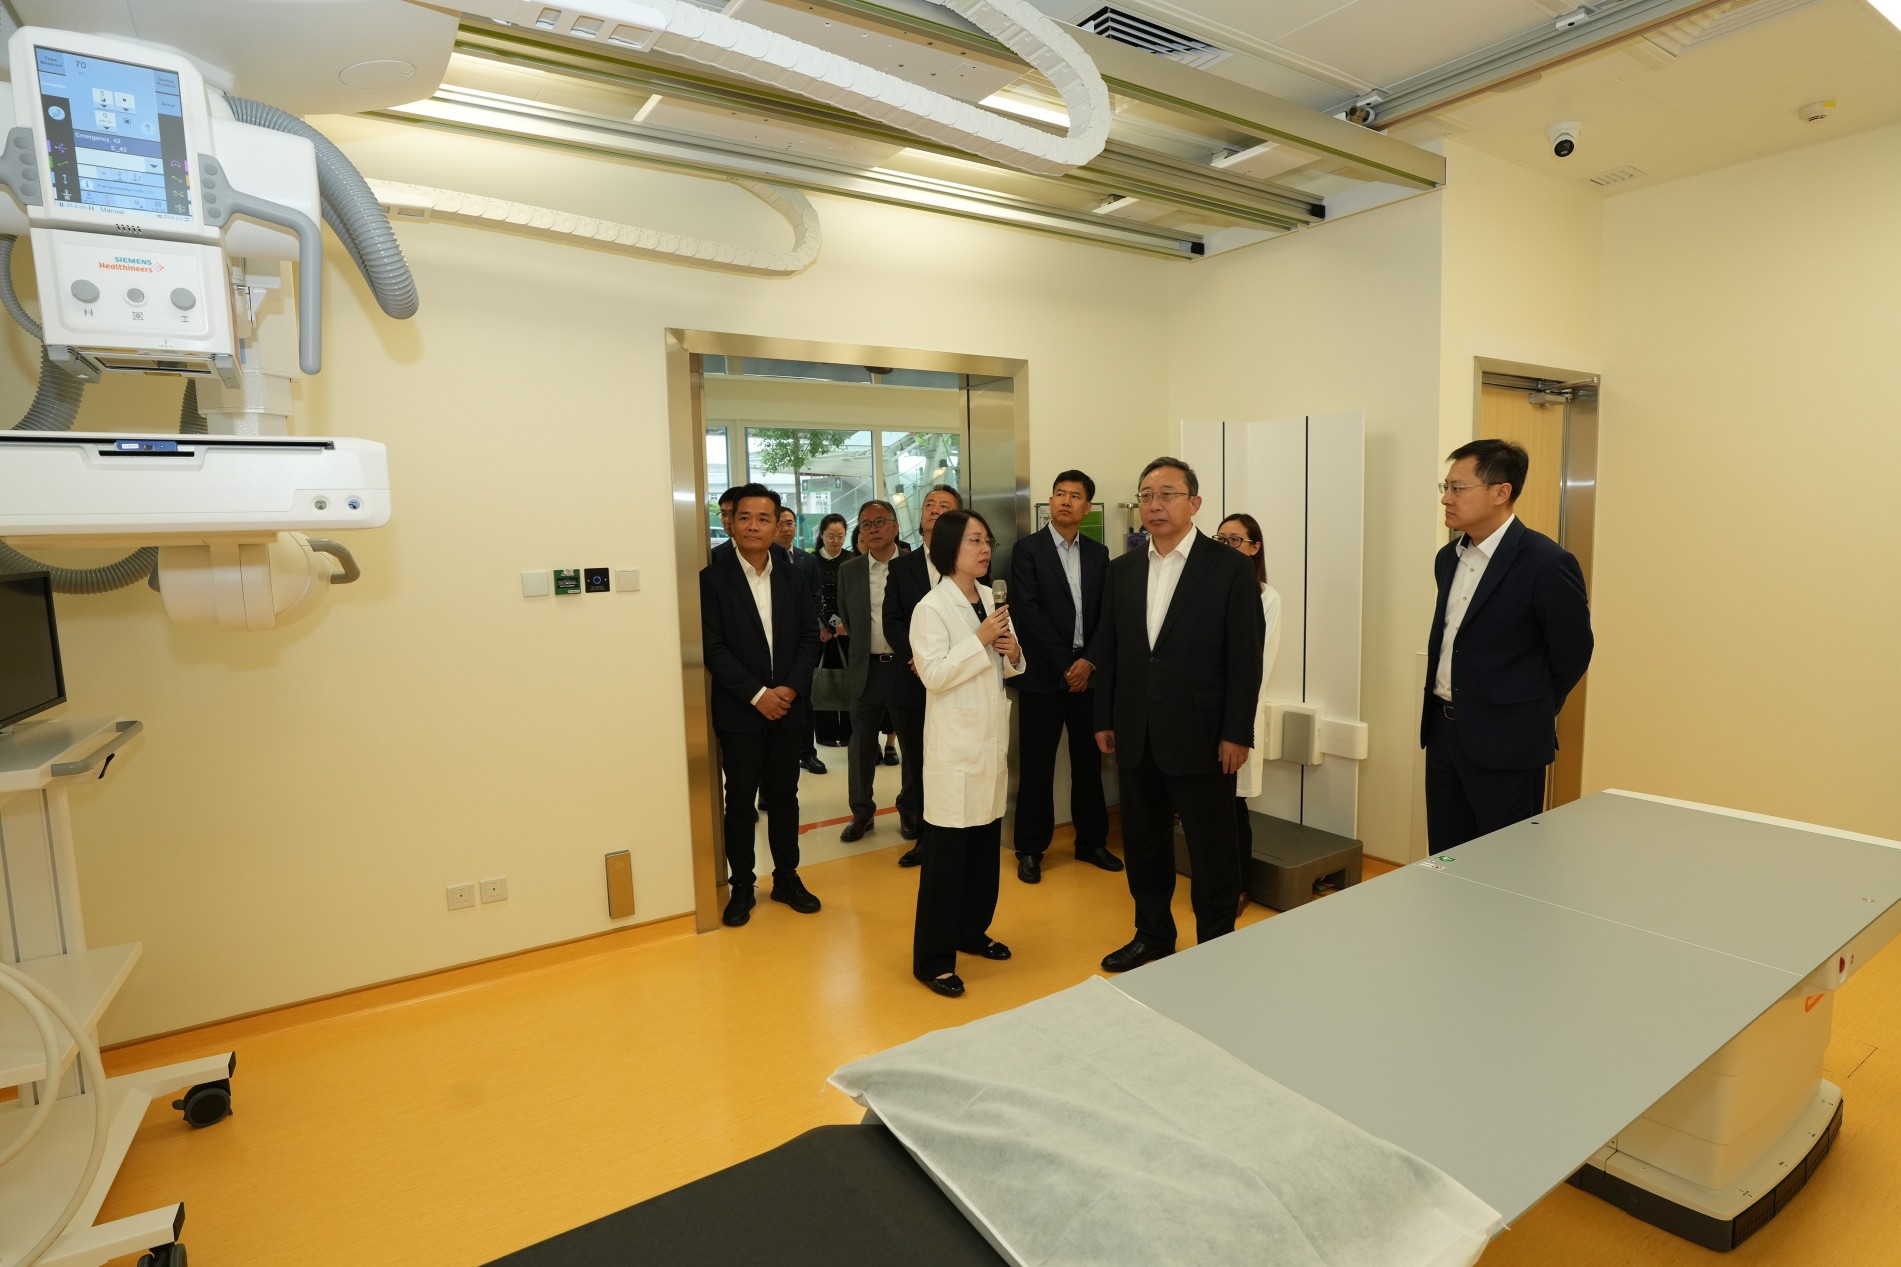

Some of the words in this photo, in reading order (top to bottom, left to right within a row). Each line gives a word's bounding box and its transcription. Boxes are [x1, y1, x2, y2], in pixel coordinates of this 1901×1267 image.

[75, 60, 87, 69] 70
[75, 132, 112, 143] Emergency,
[100, 206, 125, 215] Manual
[114, 256, 152, 265] SIEMENS
[99, 262, 153, 273] Healthineers
